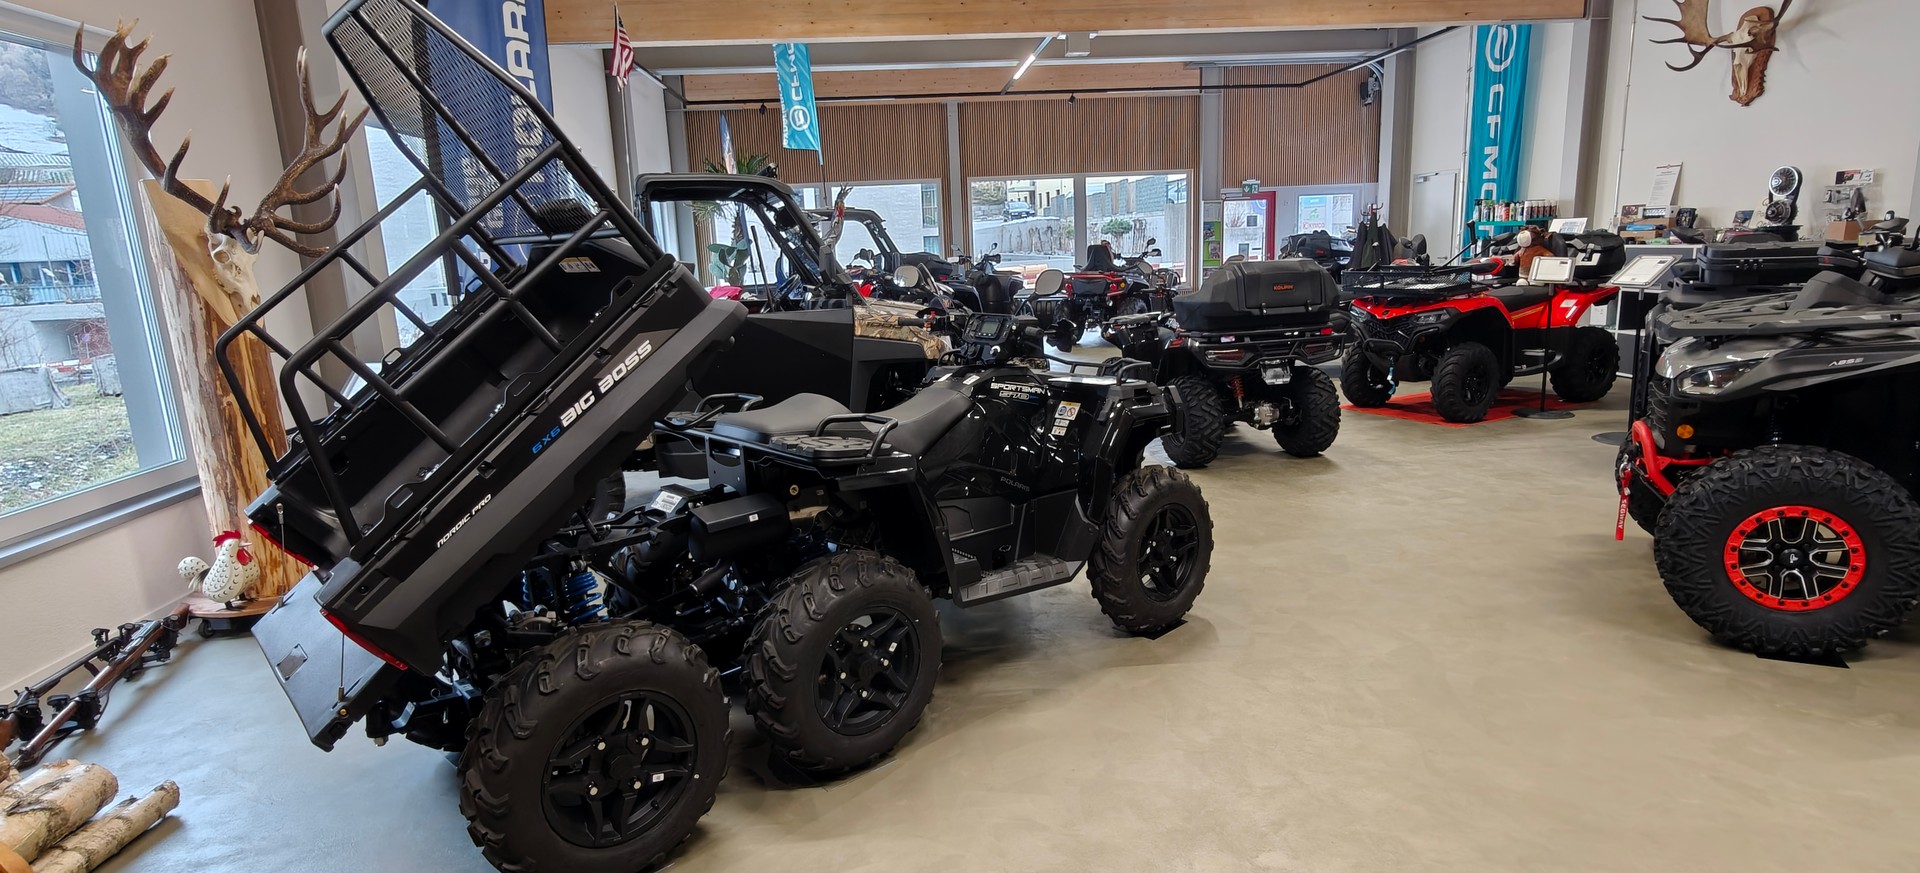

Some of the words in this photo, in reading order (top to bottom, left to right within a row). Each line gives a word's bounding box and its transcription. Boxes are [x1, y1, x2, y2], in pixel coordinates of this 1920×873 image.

[560, 390, 596, 428] BIG
[598, 340, 652, 394] BOSS
[990, 382, 1046, 395] SPORTSMAN
[1000, 476, 1031, 492] POLARIS
[436, 512, 471, 549] NORDIC
[472, 493, 493, 516] PRO
[1618, 498, 1628, 529] SEGWAY
